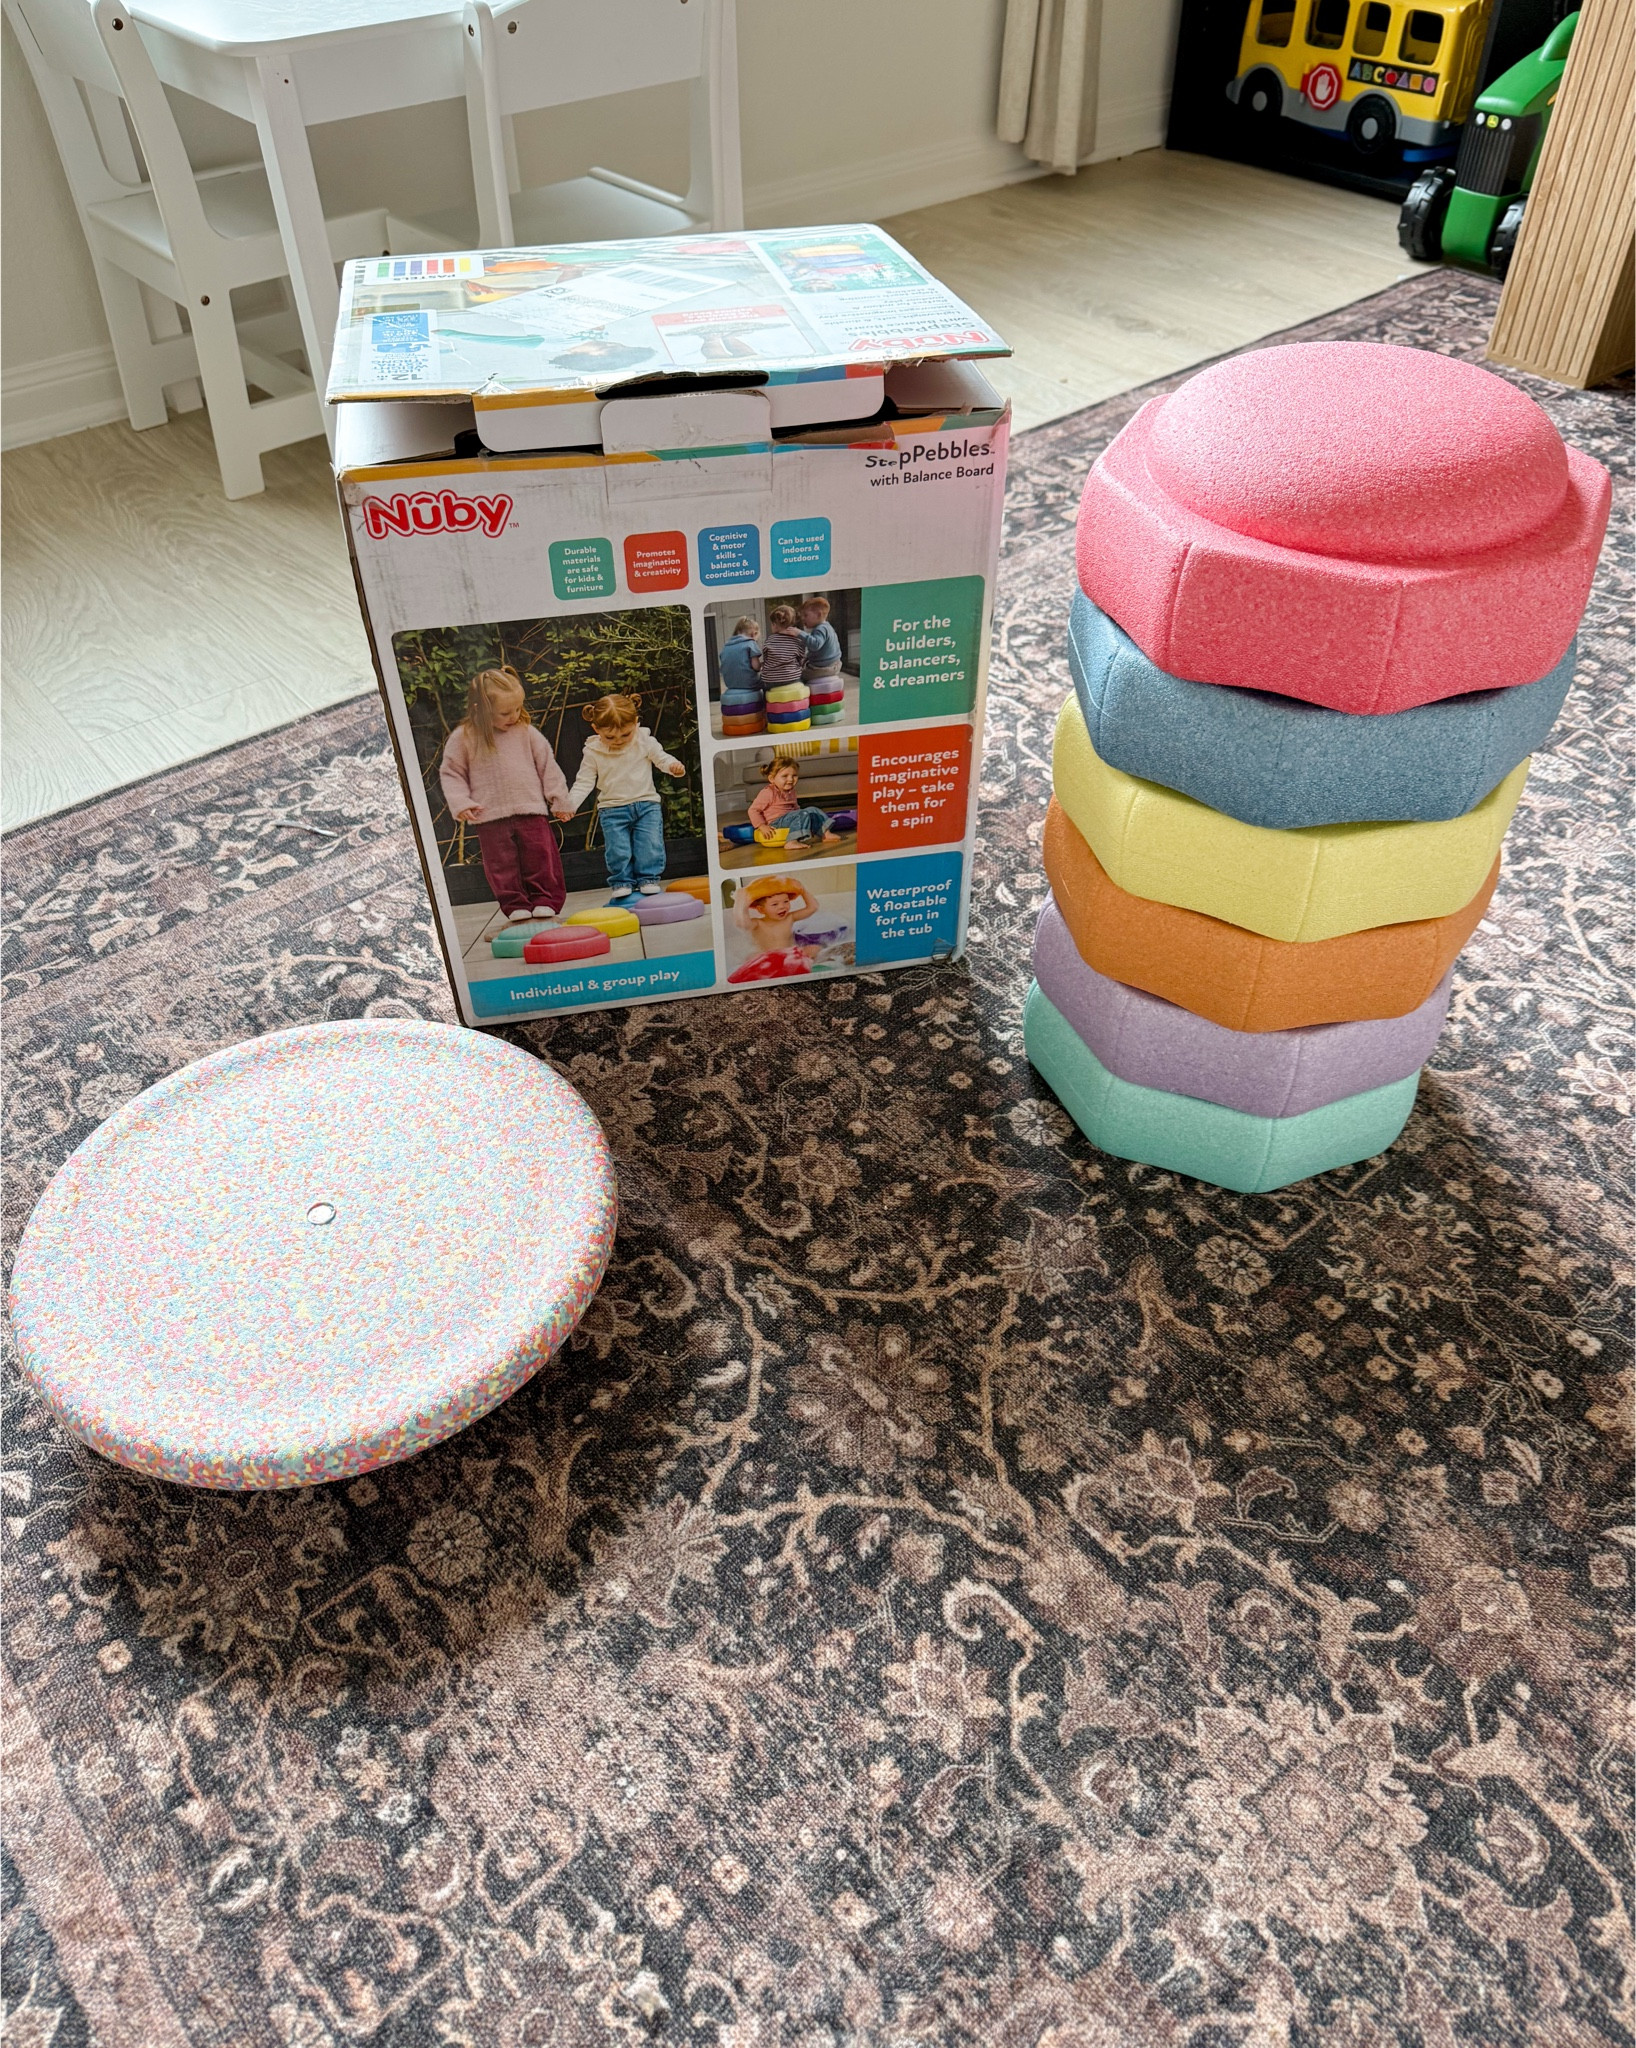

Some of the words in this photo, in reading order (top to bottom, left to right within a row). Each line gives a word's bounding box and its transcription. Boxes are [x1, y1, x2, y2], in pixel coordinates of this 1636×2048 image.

[848, 322, 976, 337] StepPebbles
[865, 439, 991, 470] StepPebbles
[870, 473, 899, 487] with
[903, 470, 952, 483] Balance
[956, 462, 994, 478] Board
[709, 532, 748, 542] Cognitive
[794, 536, 804, 544] be
[806, 534, 825, 543] used
[564, 546, 597, 555] Durable
[636, 549, 676, 558] Promotes
[720, 542, 746, 550] motor
[782, 545, 812, 554] indoors
[562, 555, 601, 565] materials
[633, 558, 681, 569] imagination
[716, 552, 736, 560] skills
[783, 554, 820, 564] outdoors
[582, 565, 599, 573] safe
[634, 570, 642, 578] &
[642, 568, 681, 576] creativity
[710, 561, 741, 570] balance
[564, 576, 576, 584] for
[578, 574, 596, 582] kids
[705, 568, 755, 580] coordination
[566, 584, 604, 593] furniture
[892, 618, 920, 633] For
[923, 614, 952, 630] the
[886, 634, 956, 652] builders,
[879, 653, 961, 671] balancers,
[872, 676, 886, 689] &
[889, 670, 965, 688] dreamers
[871, 749, 960, 768] Encourages
[869, 764, 959, 784] imaginative
[872, 786, 905, 803] play
[920, 780, 956, 794] take
[880, 801, 920, 814] them
[924, 796, 947, 809] for
[890, 820, 899, 828] a
[902, 813, 934, 829] spin
[866, 879, 953, 900] Waterproof
[869, 902, 881, 914] &
[884, 894, 948, 912] floatable
[875, 916, 898, 926] for
[900, 912, 923, 924] fun
[926, 910, 940, 920] in
[881, 928, 906, 939] the
[908, 923, 933, 936] tub
[510, 980, 584, 1001] Individual
[587, 979, 600, 990] &
[602, 975, 646, 991] group
[650, 970, 680, 985] play
